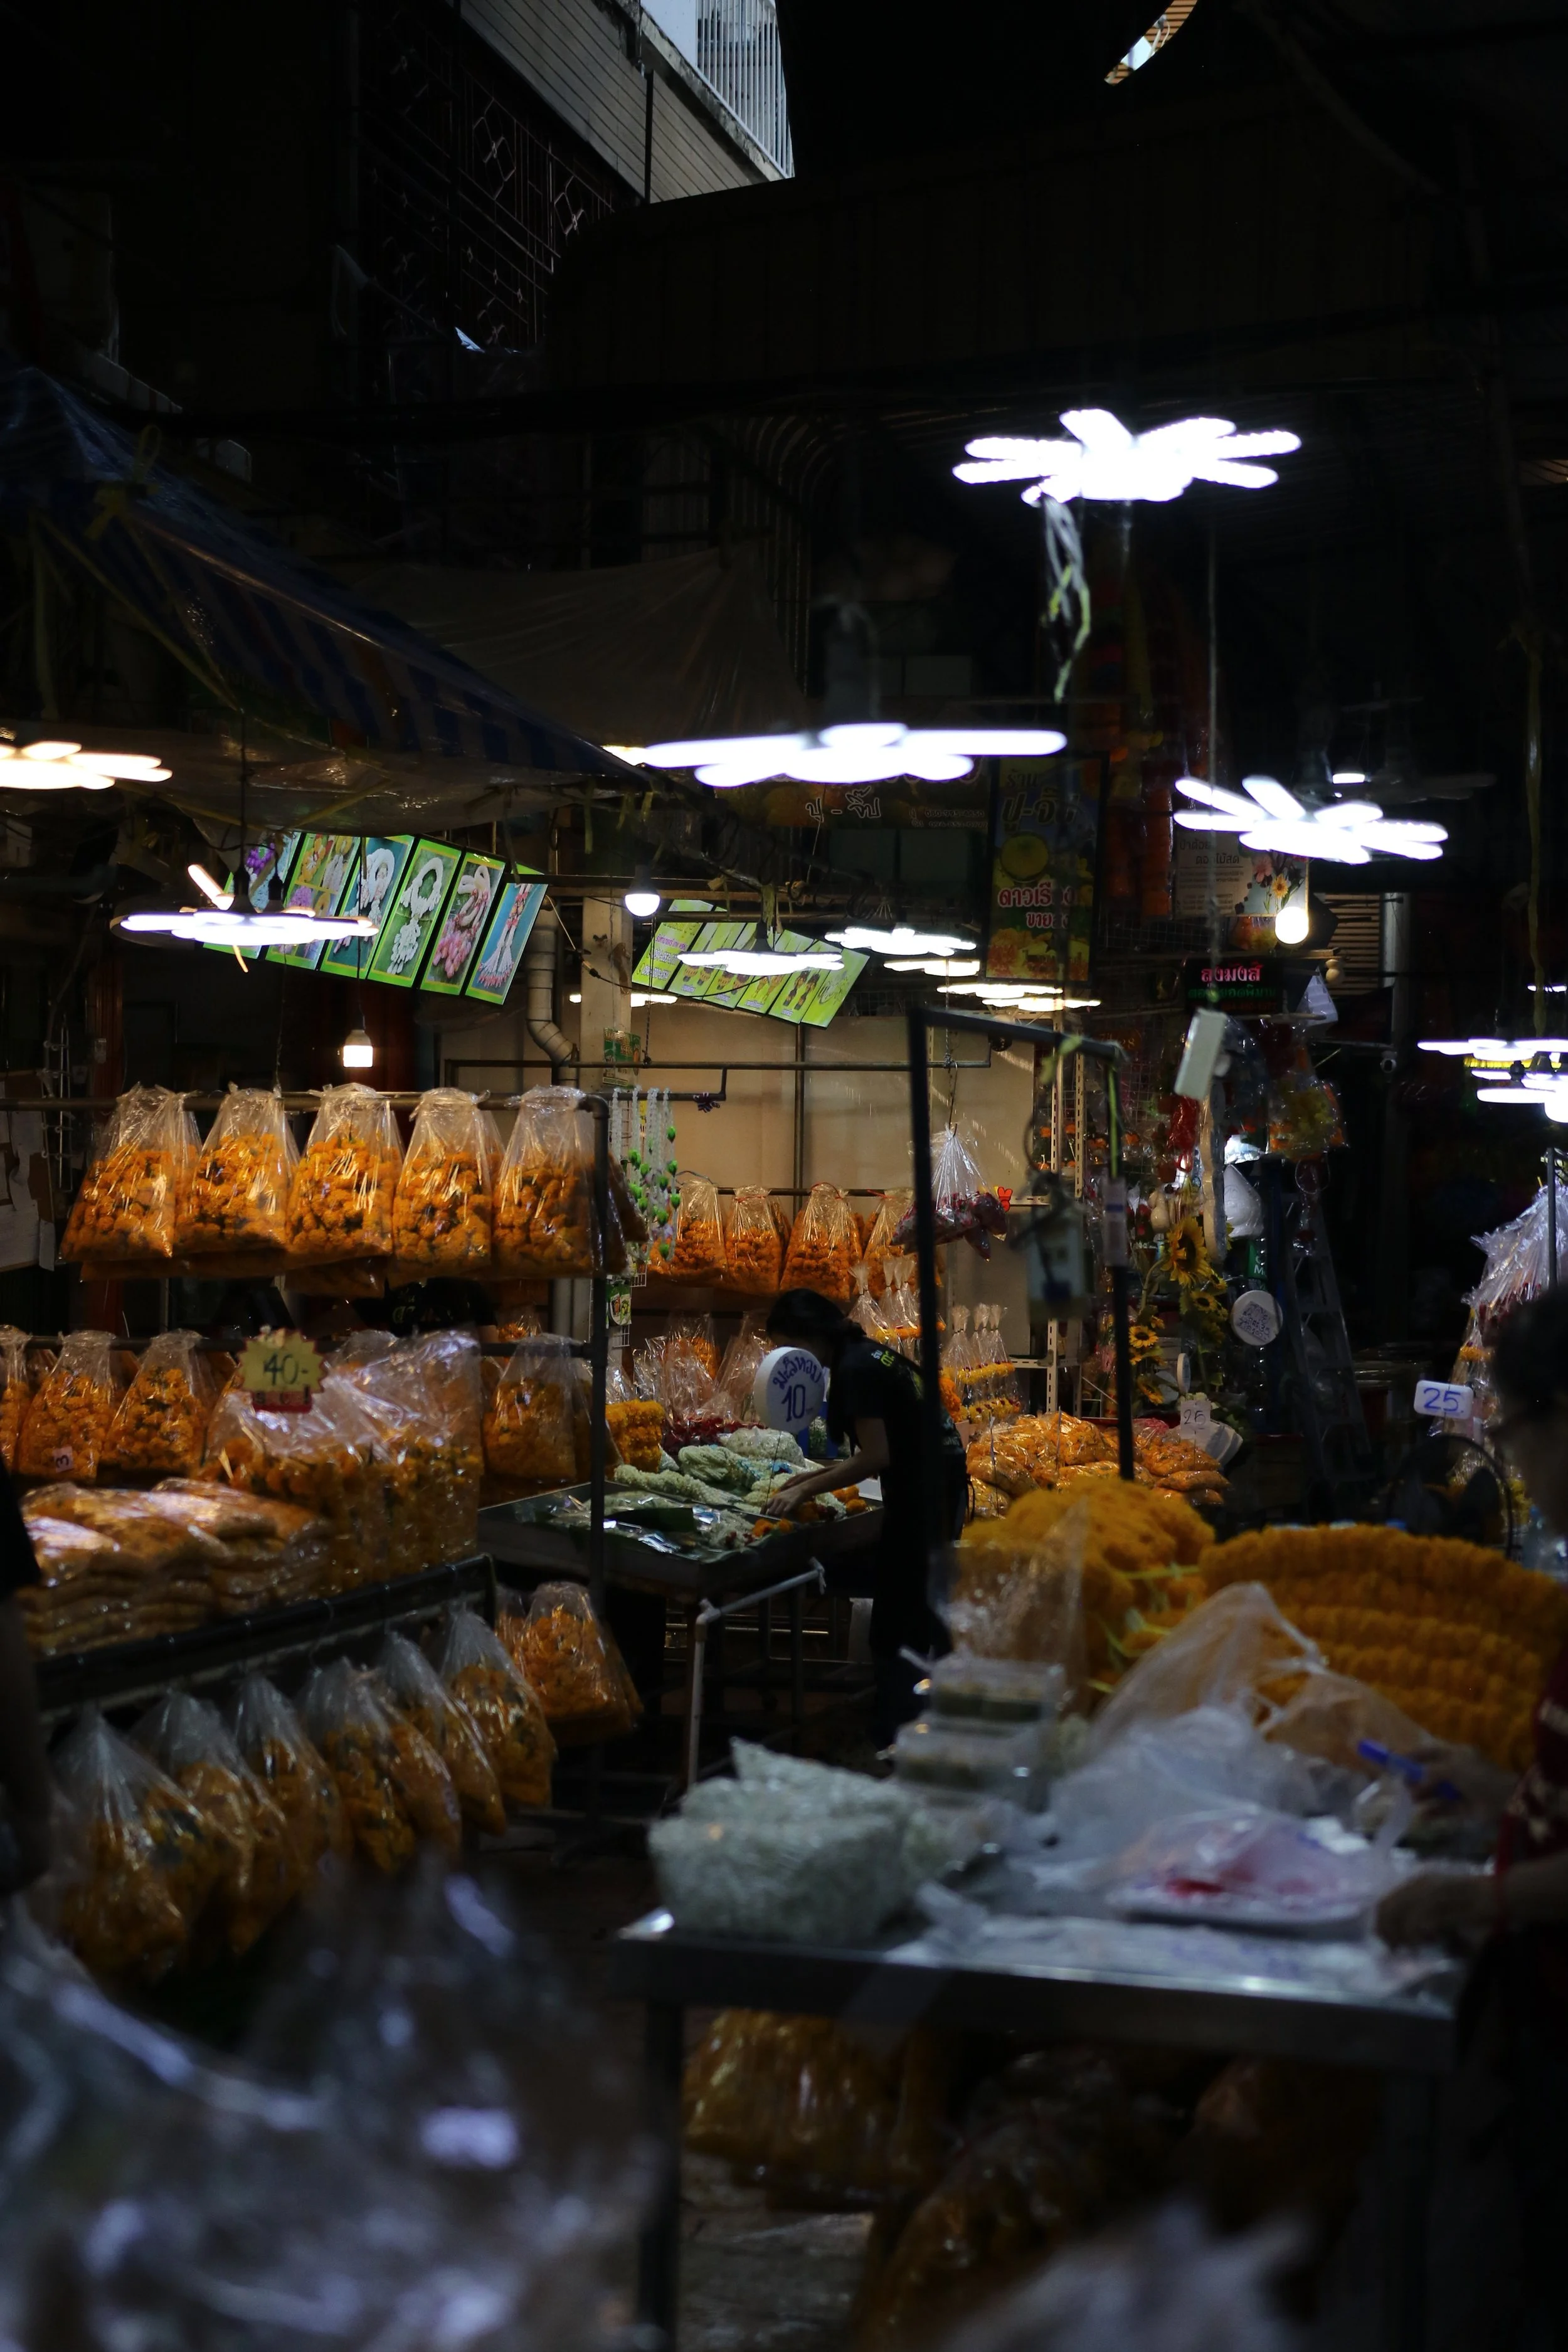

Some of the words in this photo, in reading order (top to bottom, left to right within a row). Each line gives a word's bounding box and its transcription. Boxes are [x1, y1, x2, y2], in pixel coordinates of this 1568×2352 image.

[1195, 853, 1240, 864] ดอไม้สด
[998, 880, 1076, 908] ดาวเรืง
